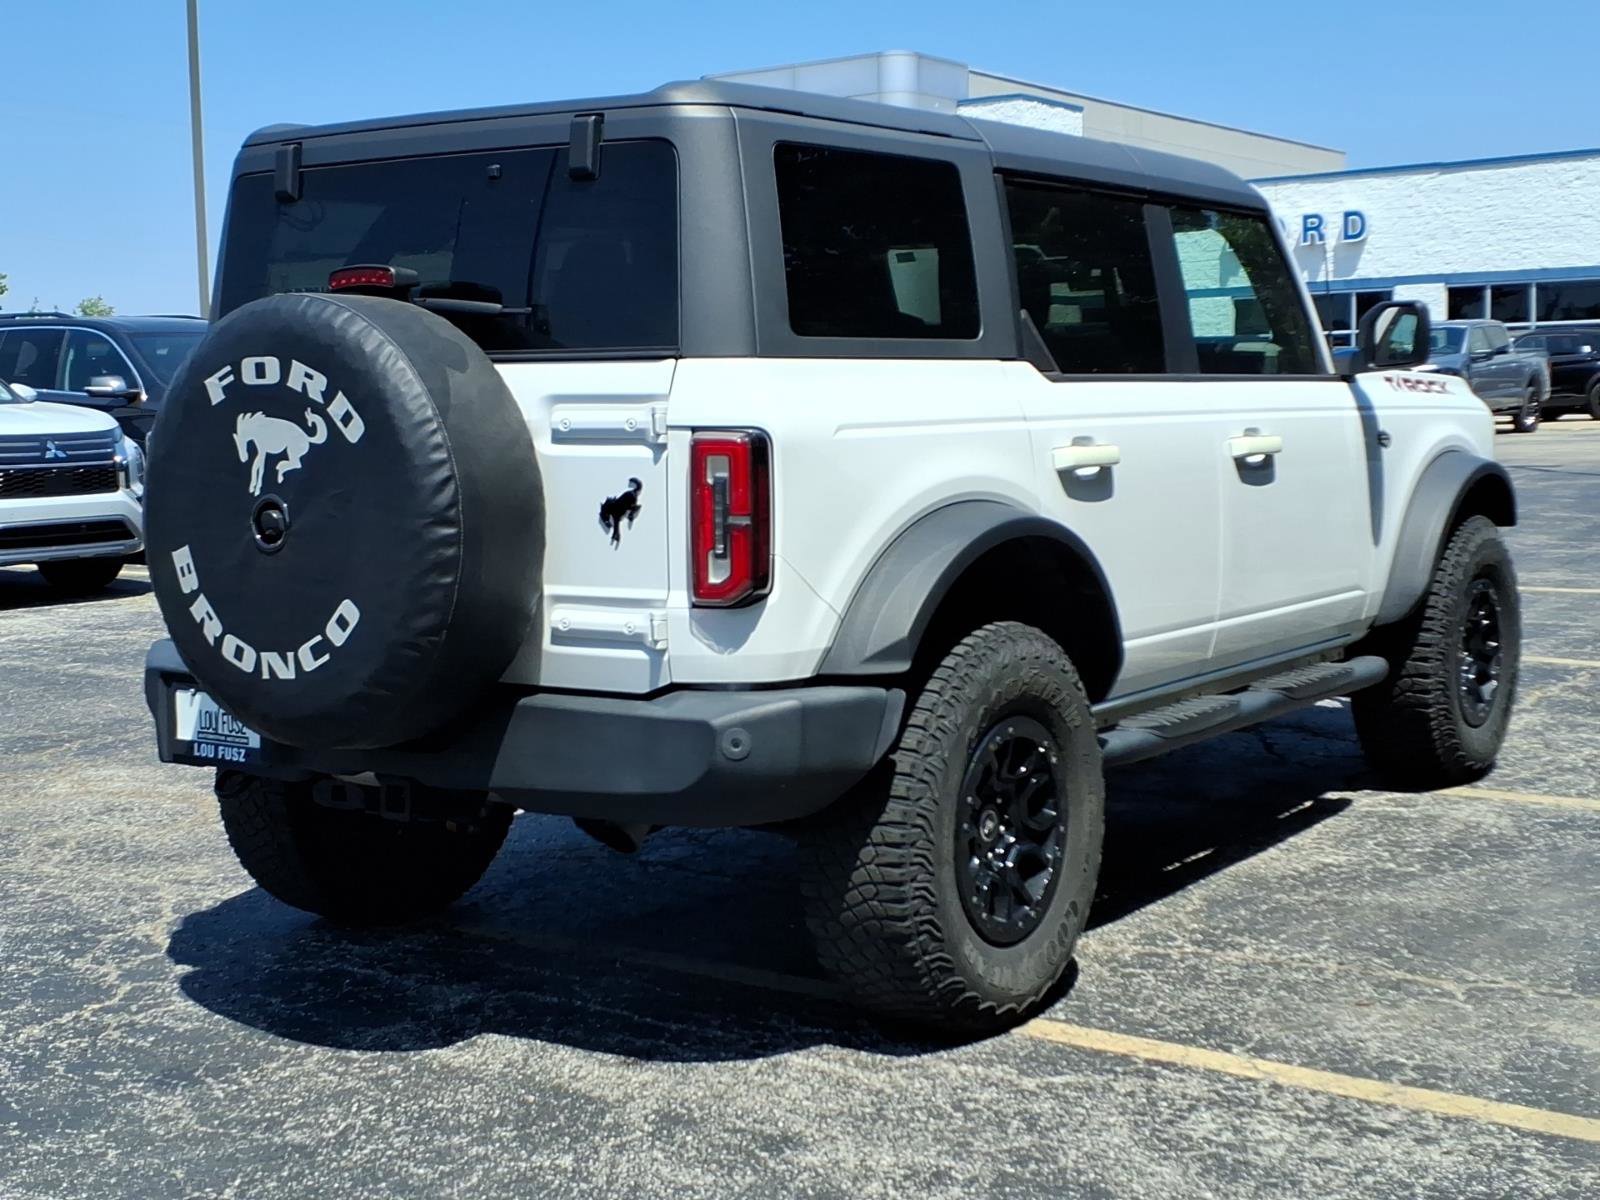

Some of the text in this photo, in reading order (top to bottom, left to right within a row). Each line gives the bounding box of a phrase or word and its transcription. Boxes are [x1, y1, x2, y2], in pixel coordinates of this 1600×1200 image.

[1279, 211, 1367, 244] RD
[204, 356, 365, 443] FORD
[171, 544, 360, 679] BRONCO
[193, 743, 246, 762] LOU FUSZ
